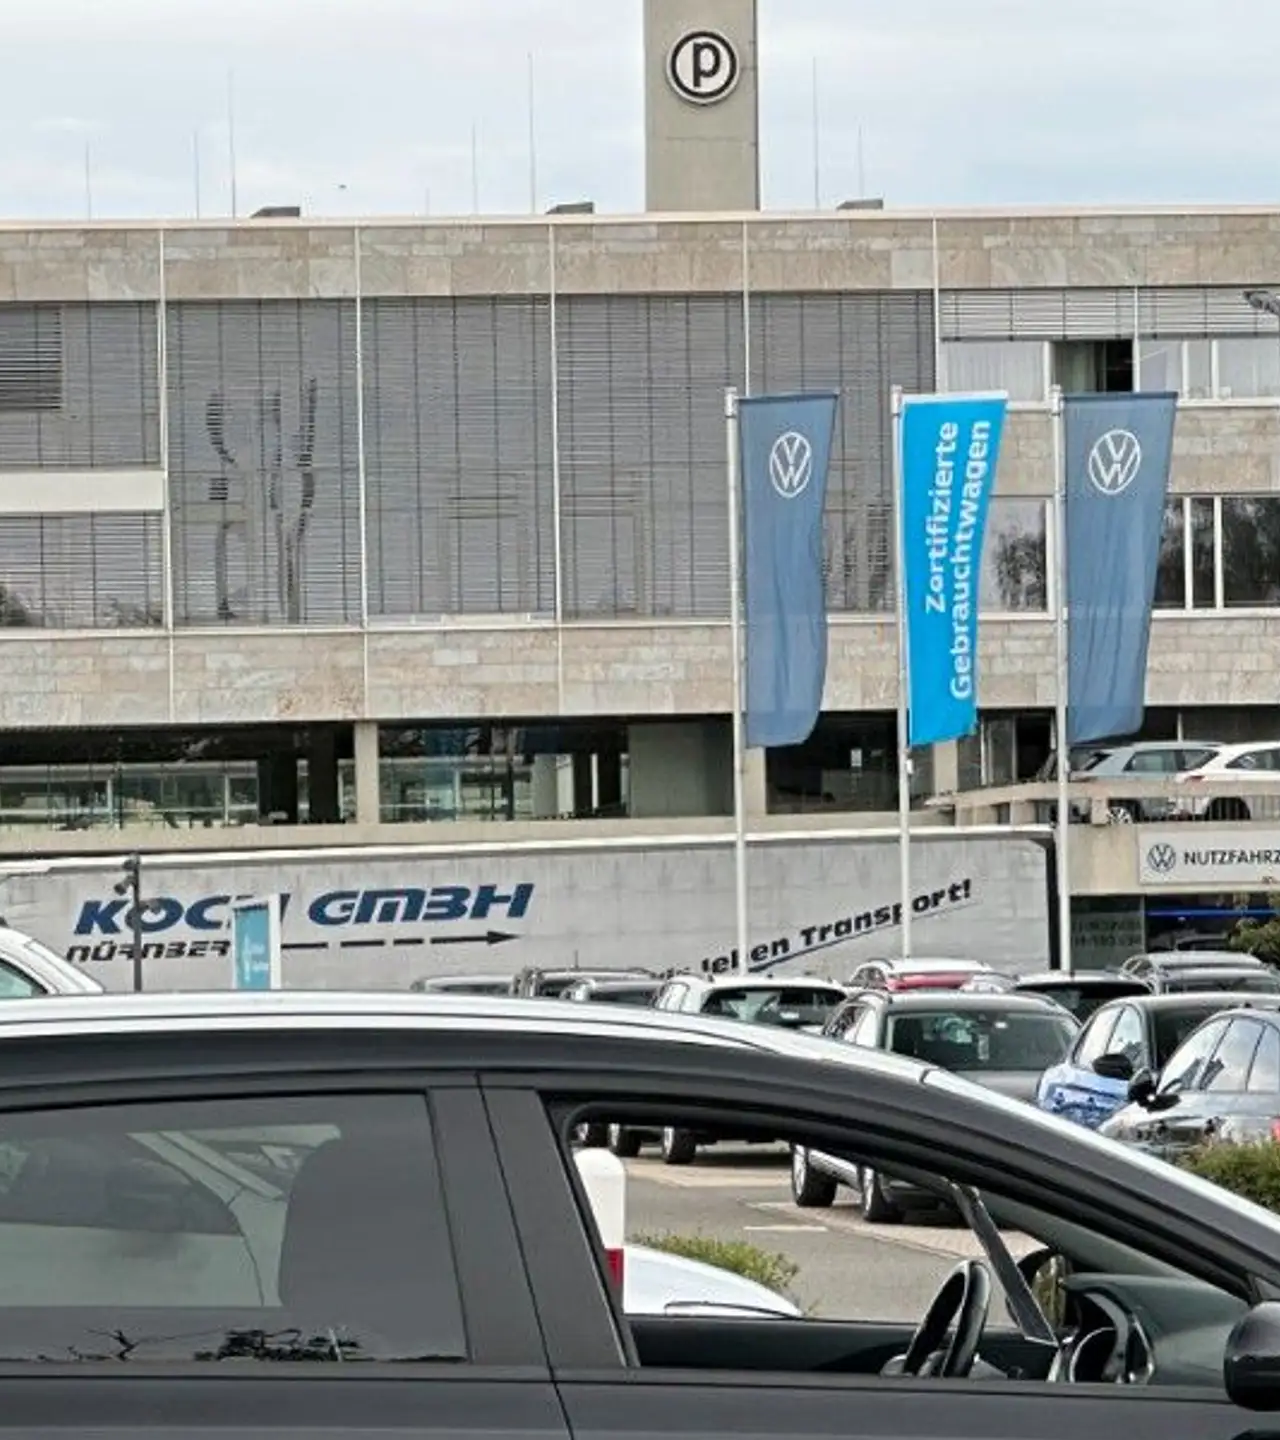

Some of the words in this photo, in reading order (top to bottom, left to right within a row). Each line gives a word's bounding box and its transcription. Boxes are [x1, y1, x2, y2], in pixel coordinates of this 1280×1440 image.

[950, 421, 991, 699] Gebrauchtwagen
[74, 893, 291, 935] KOC
[66, 940, 231, 961] NÜRNBER
